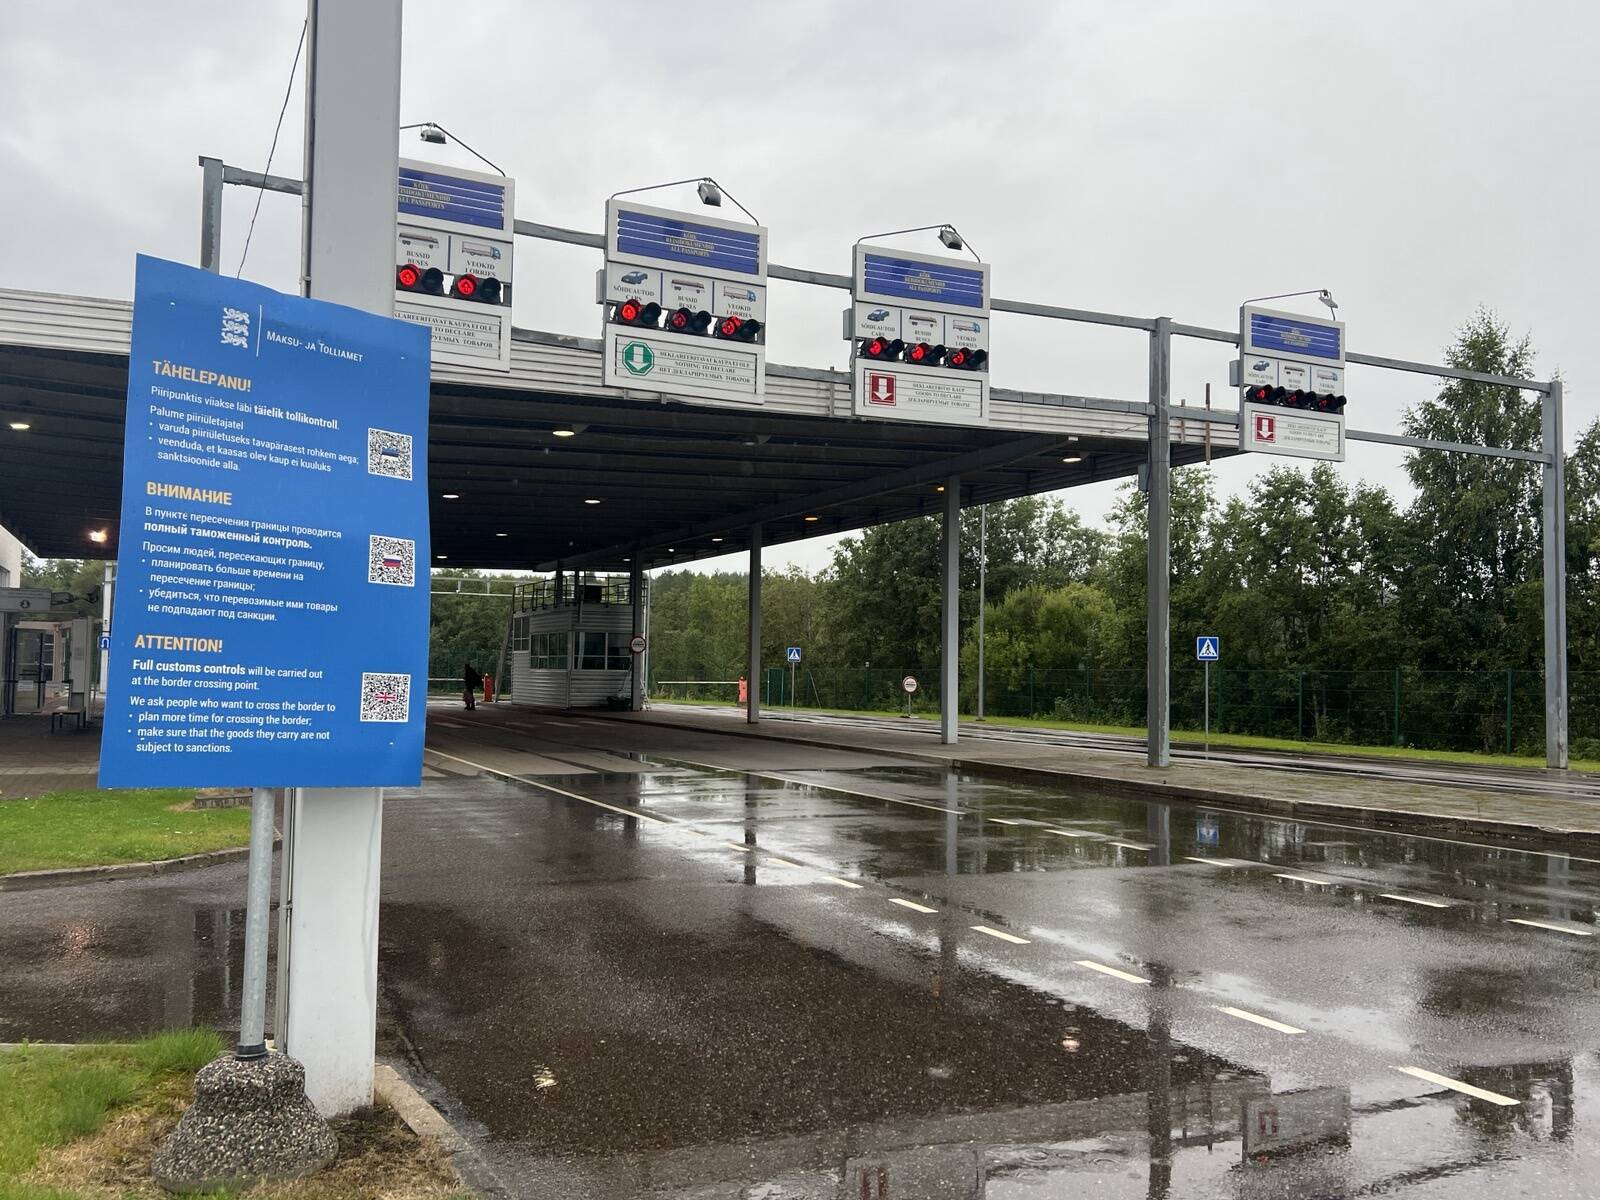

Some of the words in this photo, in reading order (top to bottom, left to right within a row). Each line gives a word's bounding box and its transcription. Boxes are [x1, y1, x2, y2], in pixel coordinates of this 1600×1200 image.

[406, 250, 430, 259] BUSSID
[467, 260, 495, 270] VEOKID
[153, 360, 251, 392] TÄHELEPANU!
[150, 405, 185, 420] Palume
[186, 412, 244, 430] piiriületajatel
[151, 386, 202, 404] Piiripunktis
[204, 397, 235, 410] viiakse
[236, 402, 252, 413] läbi
[254, 405, 284, 419] täielik
[286, 411, 339, 430] tollikontroll.
[158, 437, 204, 452] veenduda,
[206, 445, 215, 453] et
[217, 445, 248, 458] kaasas
[249, 451, 267, 461] olev
[269, 453, 290, 466] kaup
[291, 458, 299, 467] ei
[300, 458, 332, 472] kuuluks
[159, 423, 190, 435] varuda
[192, 428, 250, 445] piiriületuseks
[252, 438, 305, 455] tavapärasest
[307, 448, 337, 460] rohkem
[338, 454, 359, 465] aega;
[158, 452, 221, 468] sanktsioonide
[223, 460, 240, 471] alla.
[147, 481, 232, 506] ВНИМАНИЕ
[145, 506, 153, 516] В
[154, 509, 188, 520] пункте
[190, 514, 250, 527] пересечения
[252, 521, 290, 533] границы
[292, 526, 342, 539] проводится
[144, 522, 188, 535] полный
[190, 528, 260, 543] таможенный
[262, 536, 312, 549] контроль.
[143, 541, 181, 554] Просим
[183, 547, 216, 559] людей,
[218, 551, 287, 566] пересекающих
[288, 558, 325, 571] границу,
[151, 559, 214, 572] планировать
[216, 564, 251, 576] больше
[252, 569, 292, 580] времени
[293, 573, 304, 581] на
[150, 574, 212, 587] пересечение
[213, 580, 256, 592] границы;
[149, 588, 201, 602] убедиться,
[204, 594, 220, 602] что
[222, 595, 285, 608] перевозимые
[286, 601, 304, 609] ими
[305, 602, 338, 613] товары
[148, 604, 160, 612] не
[162, 605, 216, 617] подпадают
[218, 610, 236, 620] под
[237, 611, 277, 622] санкции.
[134, 635, 223, 653] ATTENTION!
[133, 659, 154, 671] Full
[156, 662, 202, 673] customs
[203, 664, 246, 675] controls
[248, 666, 263, 676] will
[265, 667, 276, 676] be
[277, 668, 307, 678] carried
[131, 676, 142, 685] at
[144, 676, 160, 686] the
[161, 676, 192, 688] border
[194, 679, 233, 691] crossing
[234, 680, 260, 692] point.
[130, 696, 146, 706] We
[147, 696, 164, 706] ask
[166, 698, 198, 709] people
[200, 698, 219, 708] who
[221, 701, 243, 709] want
[245, 700, 255, 710] to
[256, 702, 280, 710] cross
[282, 701, 296, 711] the
[298, 701, 325, 712] border
[327, 704, 336, 712] to
[138, 712, 160, 723] plan
[188, 713, 209, 723] time
[211, 713, 225, 723] for
[226, 714, 264, 726] crossing
[266, 714, 280, 724] the
[282, 715, 312, 726] border;
[136, 742, 172, 754] subject
[174, 743, 184, 752] to
[186, 742, 232, 753] sanctions.
[138, 727, 164, 749] make
[166, 729, 187, 737] sure
[189, 727, 208, 738] that
[210, 728, 225, 738] the
[226, 728, 254, 740] goods
[256, 729, 275, 741] they
[276, 731, 299, 741] carry
[316, 732, 330, 740] not
